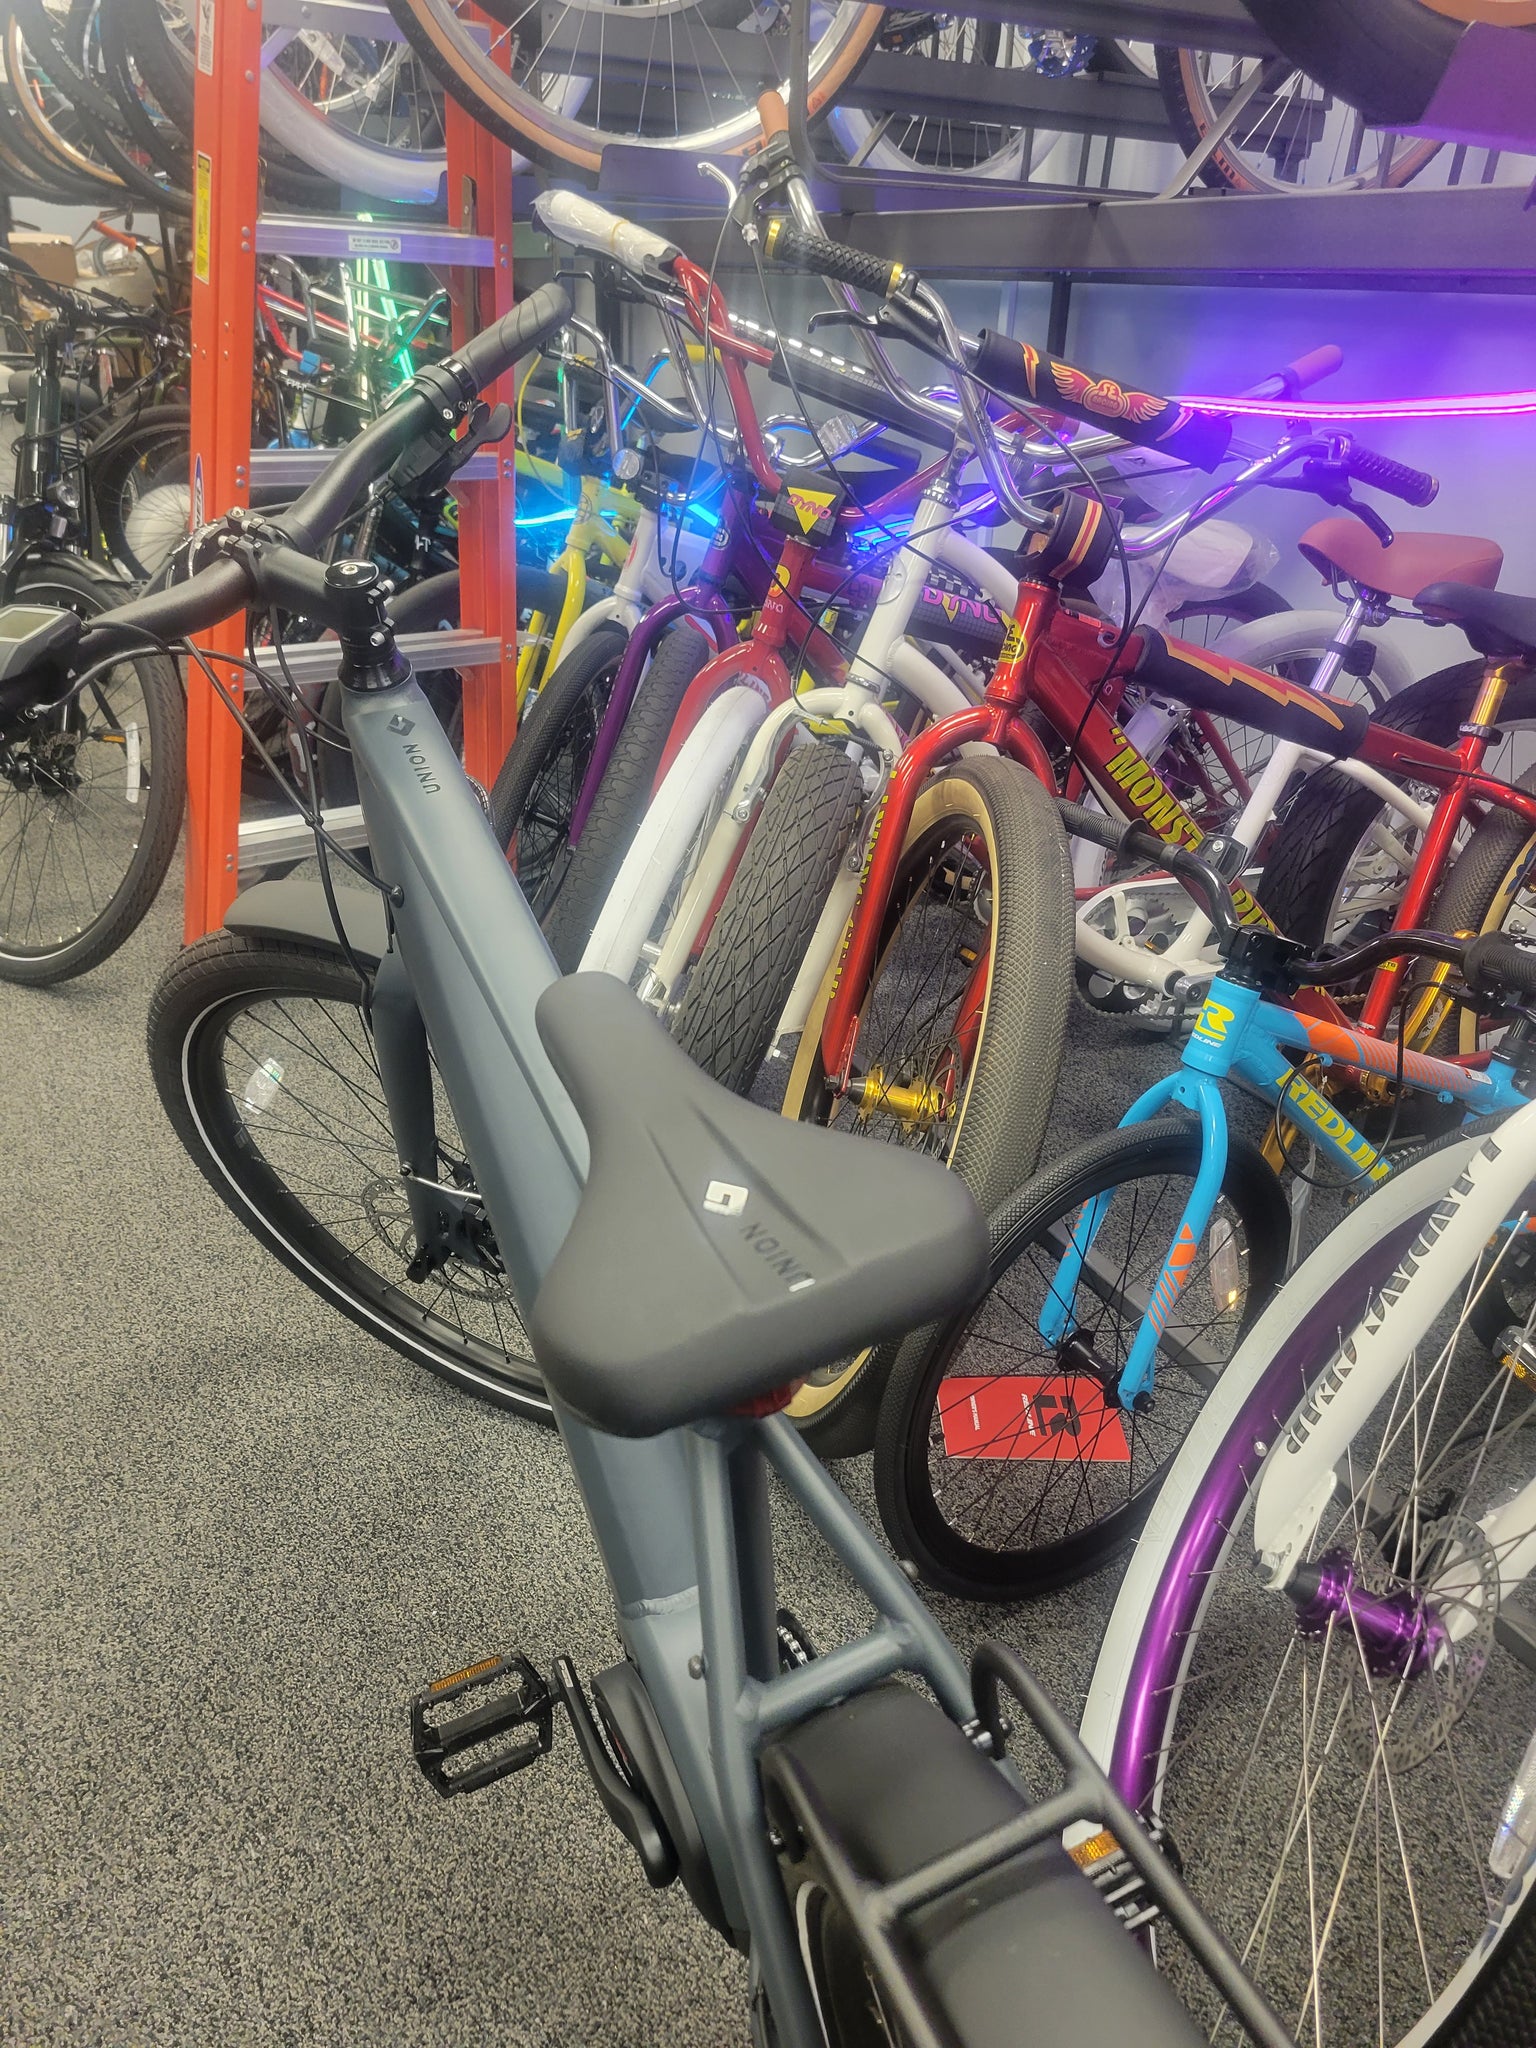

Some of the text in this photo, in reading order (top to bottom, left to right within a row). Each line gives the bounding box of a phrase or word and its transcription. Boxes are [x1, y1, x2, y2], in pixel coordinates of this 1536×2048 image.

[1098, 383, 1118, 401] SE
[786, 493, 832, 520] DYNO
[402, 743, 441, 794] UNION
[739, 1221, 817, 1293] UNION
